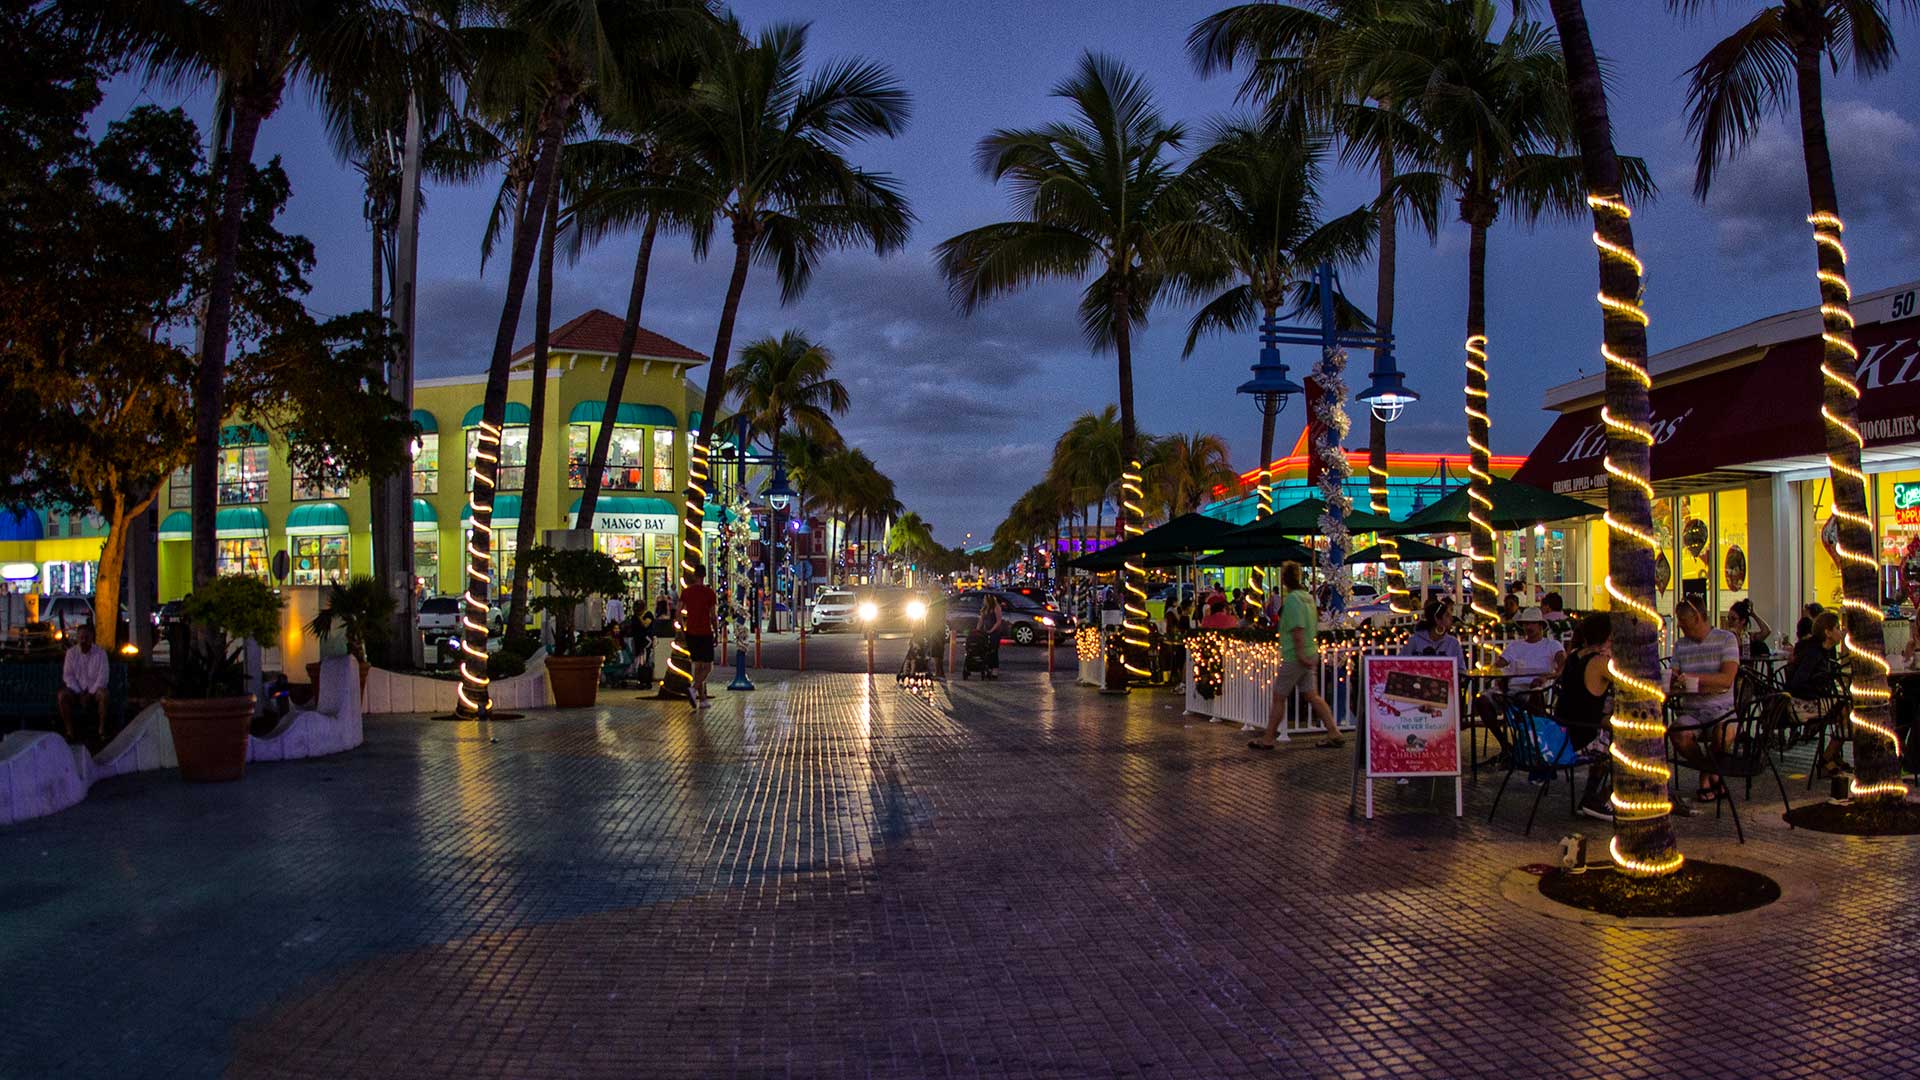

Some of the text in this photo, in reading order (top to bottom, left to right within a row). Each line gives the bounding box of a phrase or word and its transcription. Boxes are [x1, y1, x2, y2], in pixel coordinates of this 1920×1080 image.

[1892, 291, 1915, 319] 50
[1855, 338, 1920, 390] Ki
[1858, 416, 1916, 440] HOCOLATES
[601, 518, 666, 530] MANGO BAY
[1390, 751, 1440, 759] CHRISTMAS
